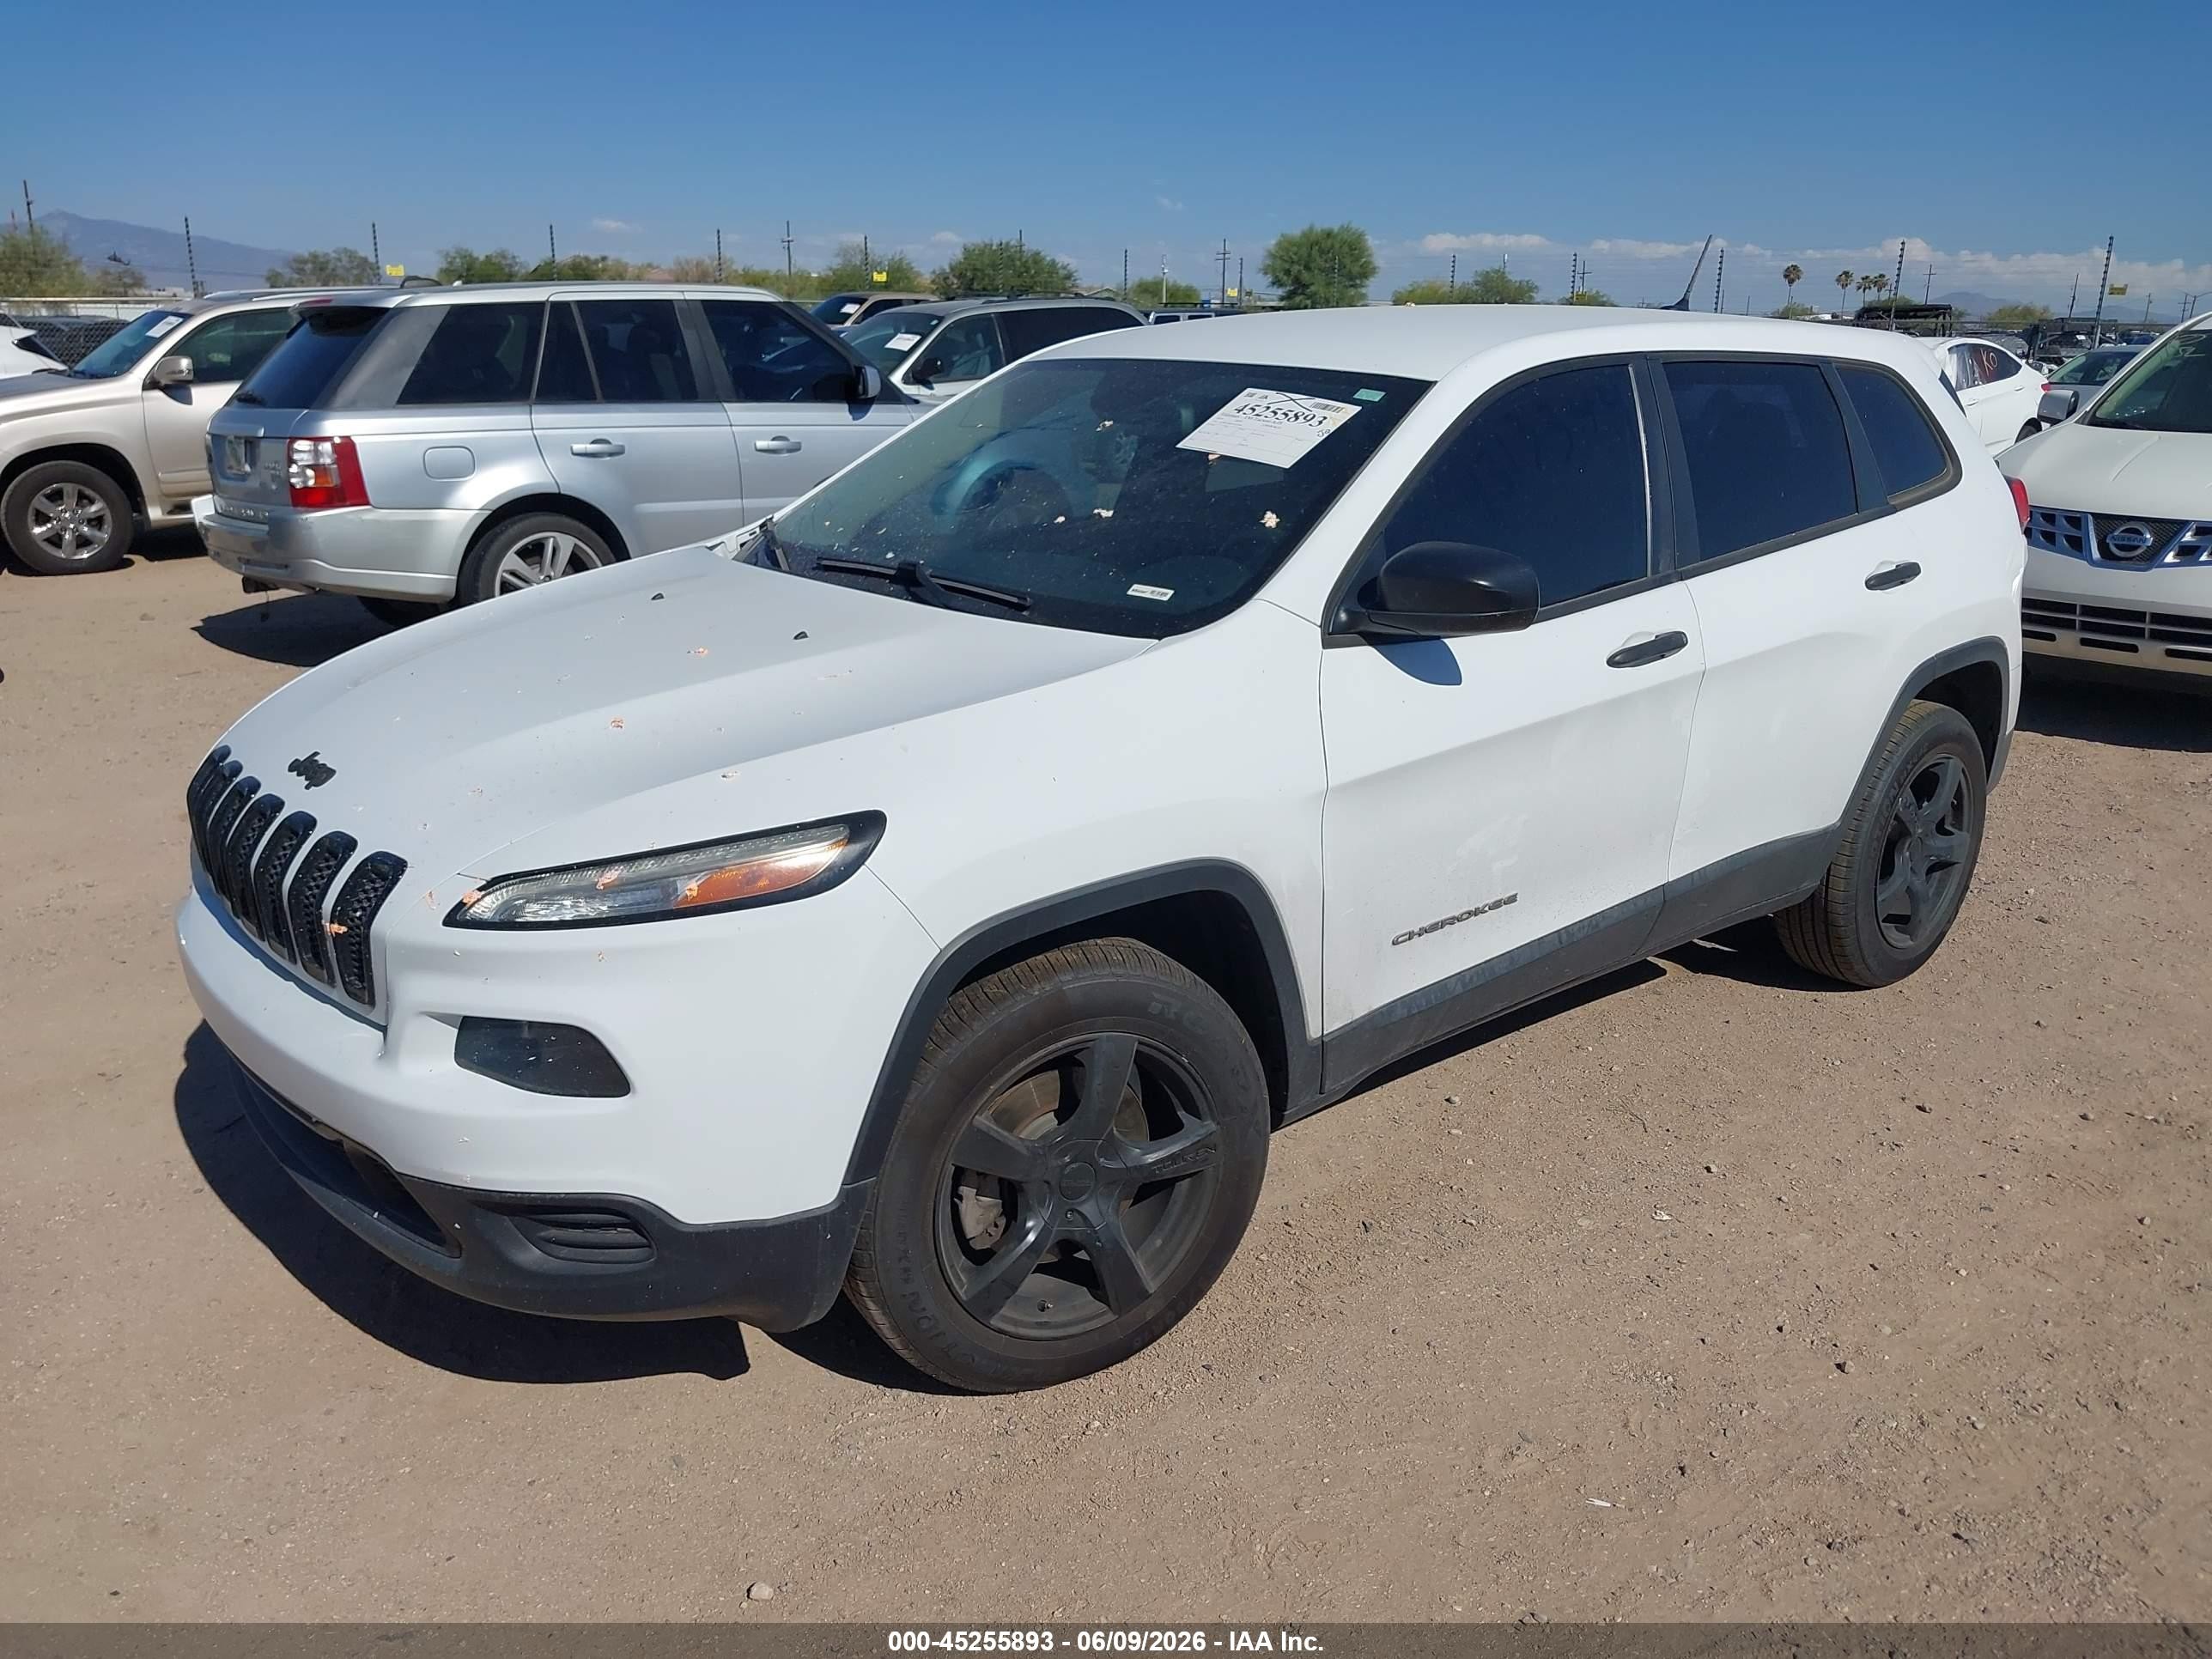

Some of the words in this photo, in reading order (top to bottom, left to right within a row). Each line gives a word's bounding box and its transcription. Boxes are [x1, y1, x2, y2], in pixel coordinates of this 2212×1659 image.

[1234, 403, 1328, 428] 45255893
[2111, 534, 2147, 545] NISSAN
[1392, 892, 1518, 945] CHEROKEE
